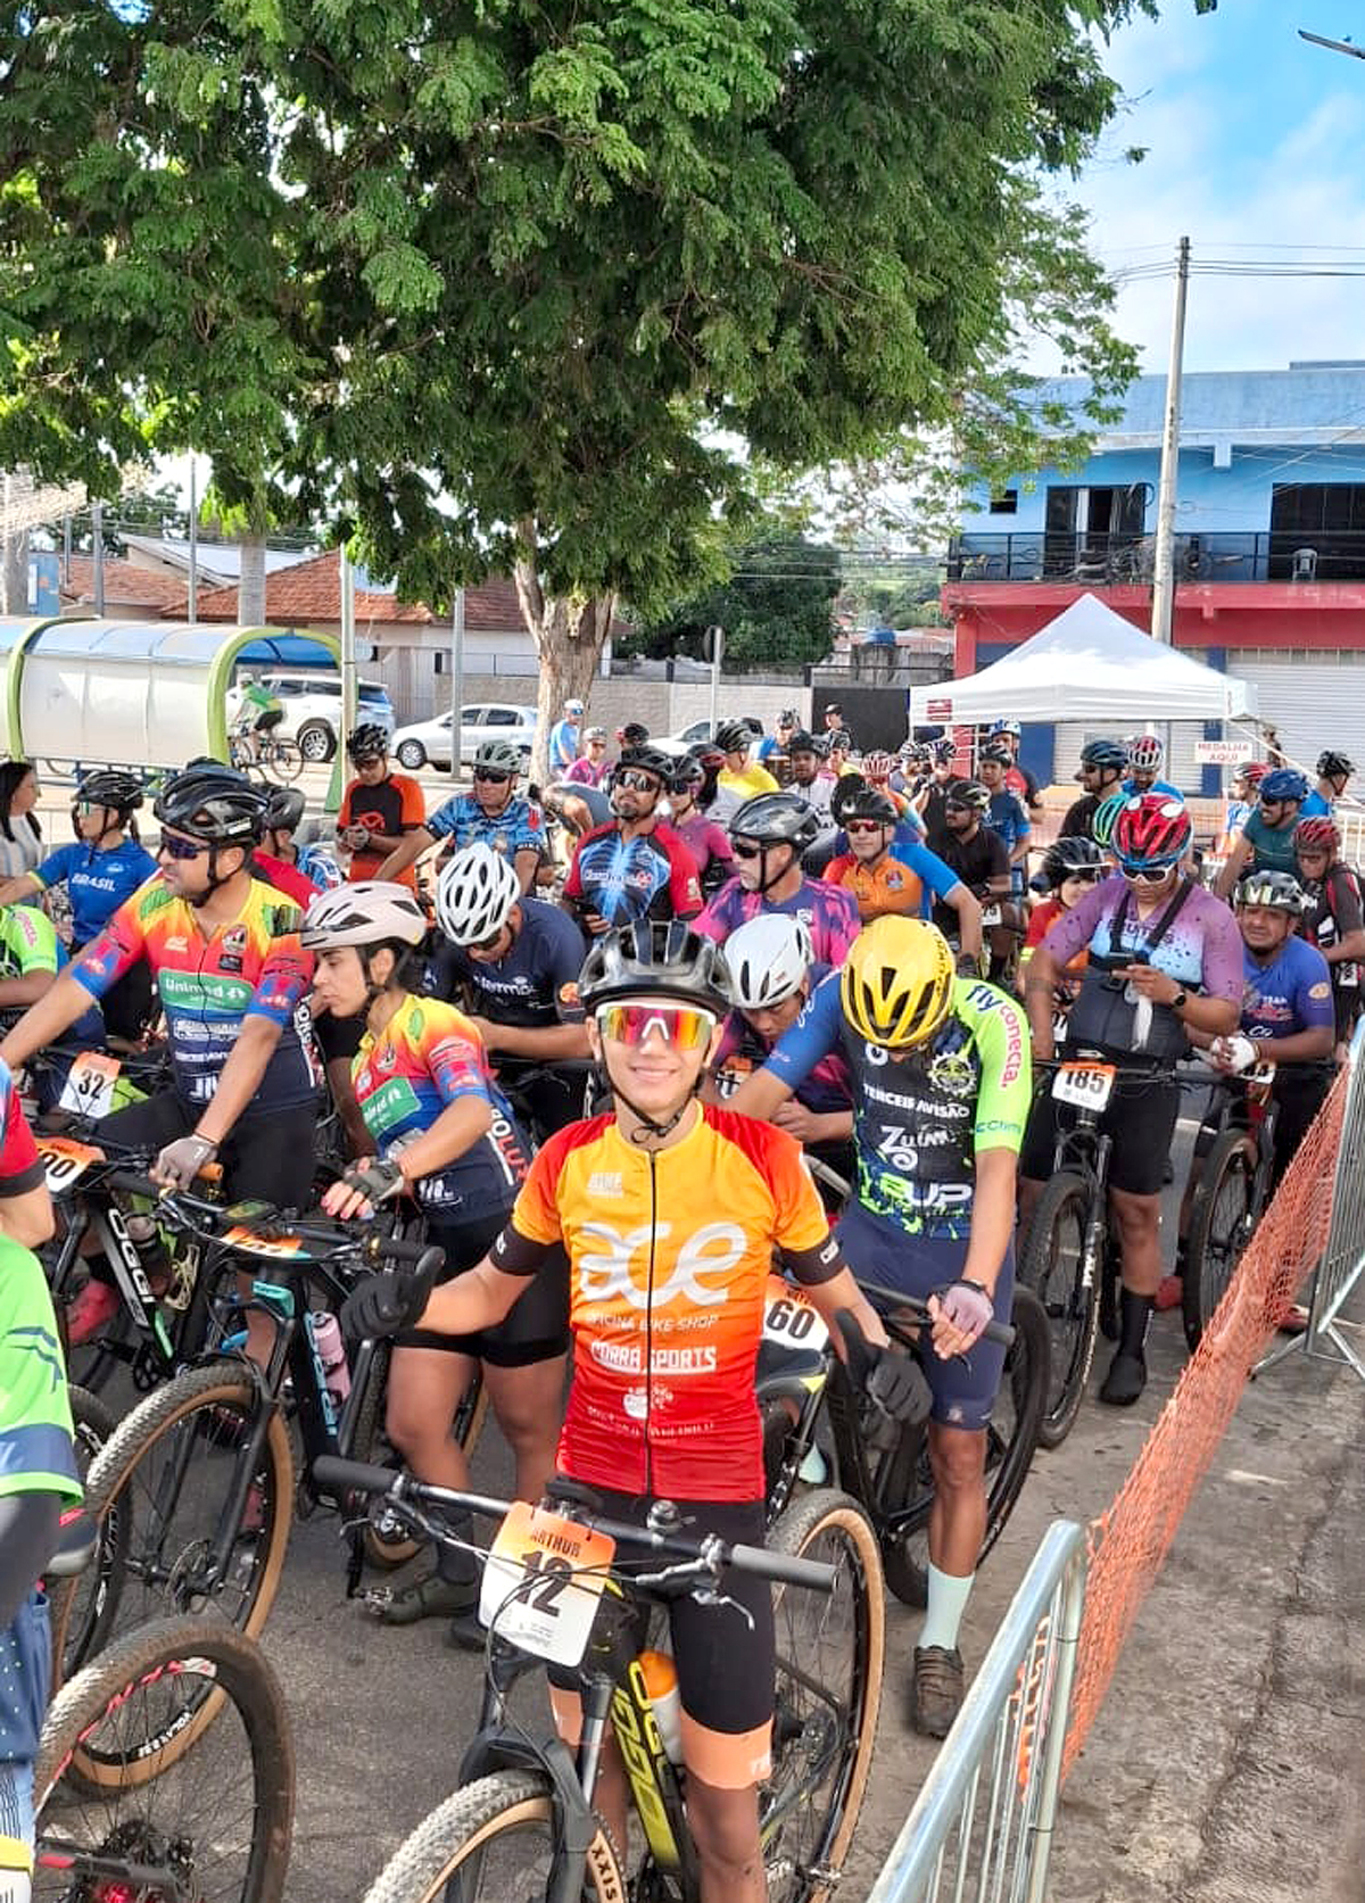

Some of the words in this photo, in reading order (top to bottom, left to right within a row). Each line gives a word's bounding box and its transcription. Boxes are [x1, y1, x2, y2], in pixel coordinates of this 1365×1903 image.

[1198, 743, 1248, 752] MEDALHA
[1209, 753, 1238, 762] AQUI
[72, 873, 116, 892] BRASIL
[165, 978, 223, 997] Unimed
[78, 1068, 105, 1100] 32
[1065, 1070, 1105, 1095] 185
[107, 1207, 156, 1304] OGGI
[766, 1299, 816, 1341] 60
[530, 1527, 582, 1559] ARTHUR
[516, 1550, 573, 1617] 12
